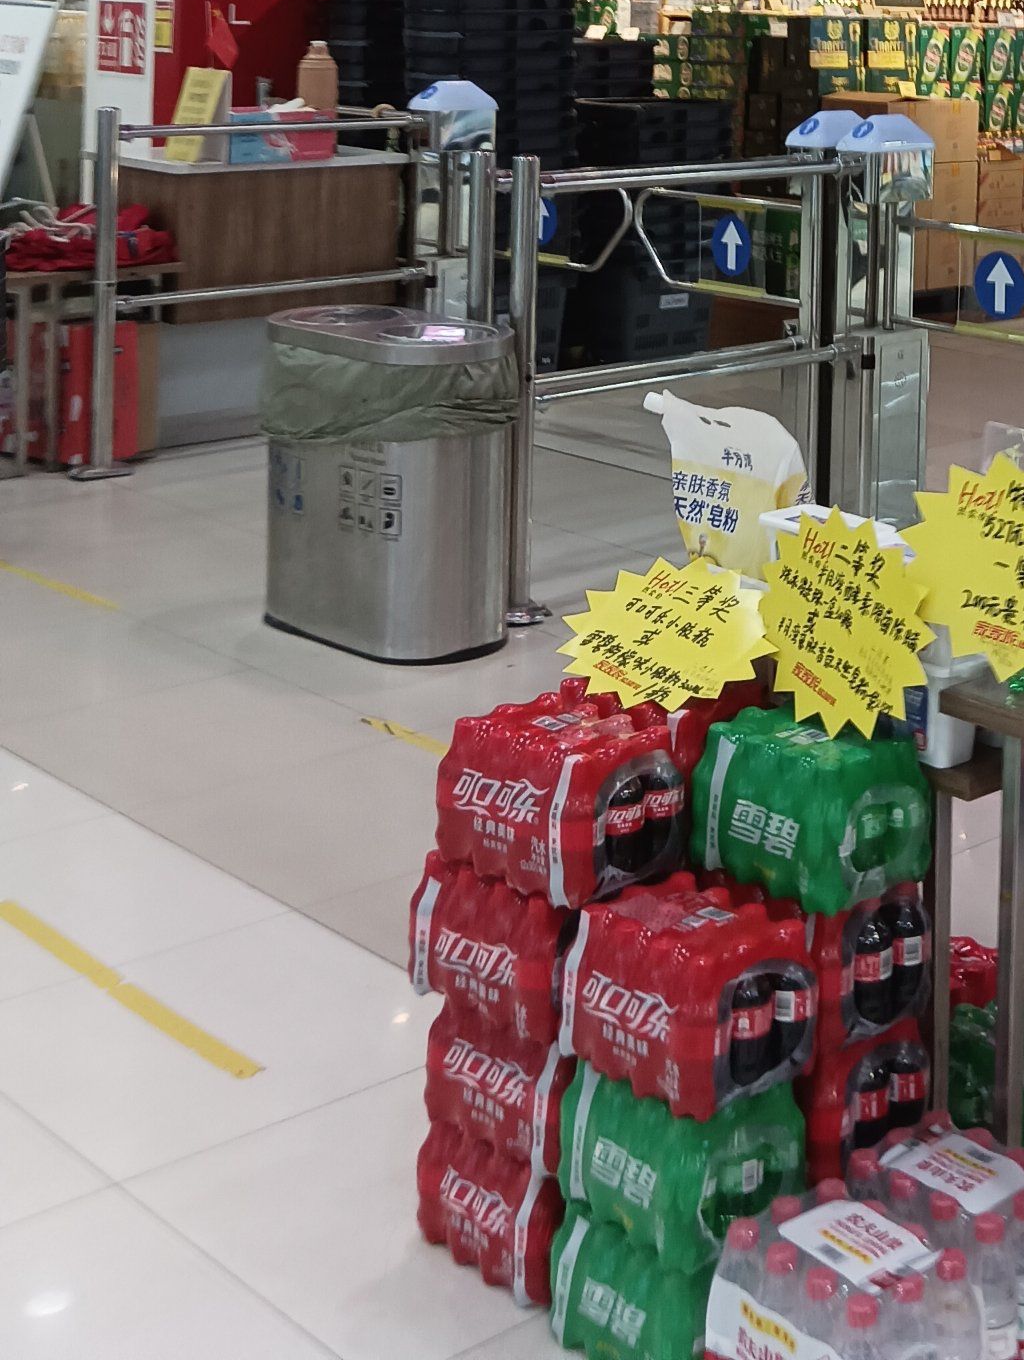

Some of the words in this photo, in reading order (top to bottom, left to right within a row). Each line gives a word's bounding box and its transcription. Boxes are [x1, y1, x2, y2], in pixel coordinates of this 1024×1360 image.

[672, 470, 733, 503] 亲肤香氛
[673, 495, 739, 534] 天然皂粉
[648, 569, 688, 597] Hot!
[834, 539, 886, 590] 二等奖
[672, 583, 741, 624] 三等奖
[451, 767, 550, 824] 可口可乐
[727, 798, 800, 860] 雪碧
[433, 925, 519, 987] 可口可乐
[581, 968, 681, 1043] 可口可乐
[442, 1036, 535, 1109] 可口可乐
[439, 1163, 514, 1239] 可口可乐
[589, 1135, 658, 1211] 雪碧
